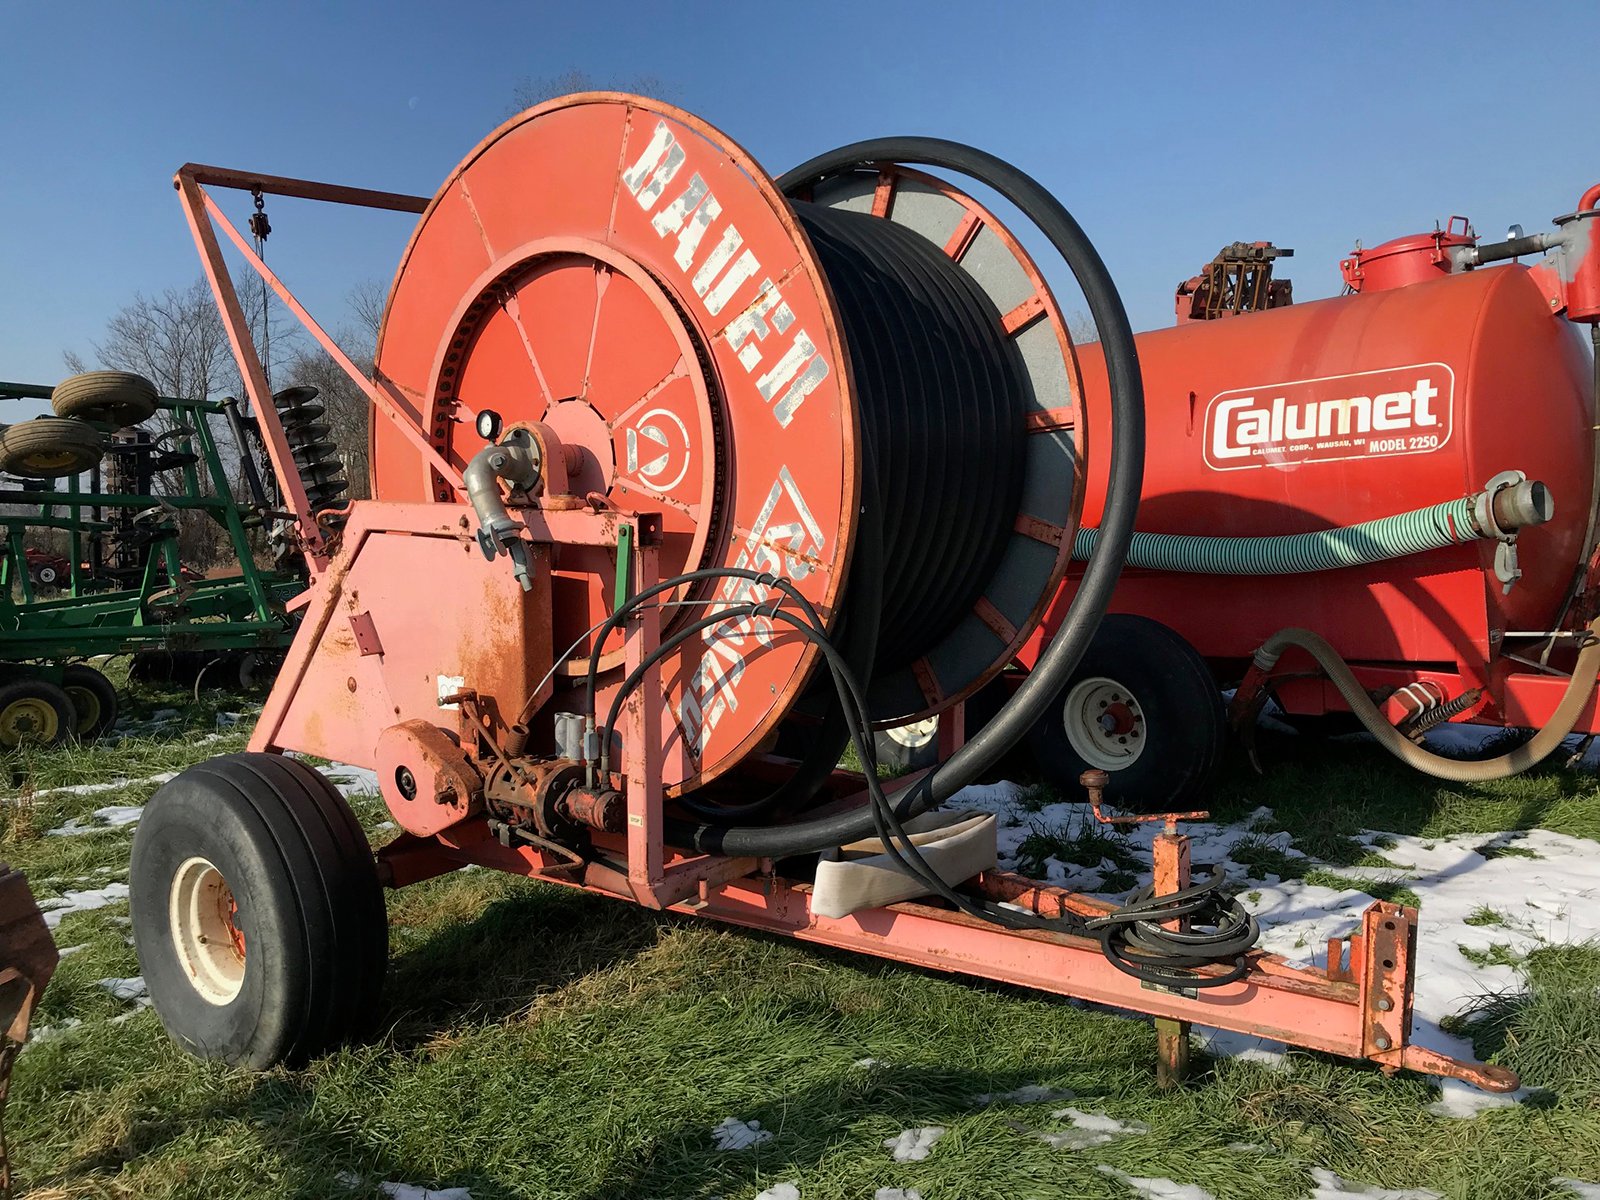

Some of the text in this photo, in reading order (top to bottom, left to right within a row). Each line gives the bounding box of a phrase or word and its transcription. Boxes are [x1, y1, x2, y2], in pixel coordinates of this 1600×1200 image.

[622, 119, 829, 429] BAUER
[1369, 435, 1438, 453] MODEL 2250
